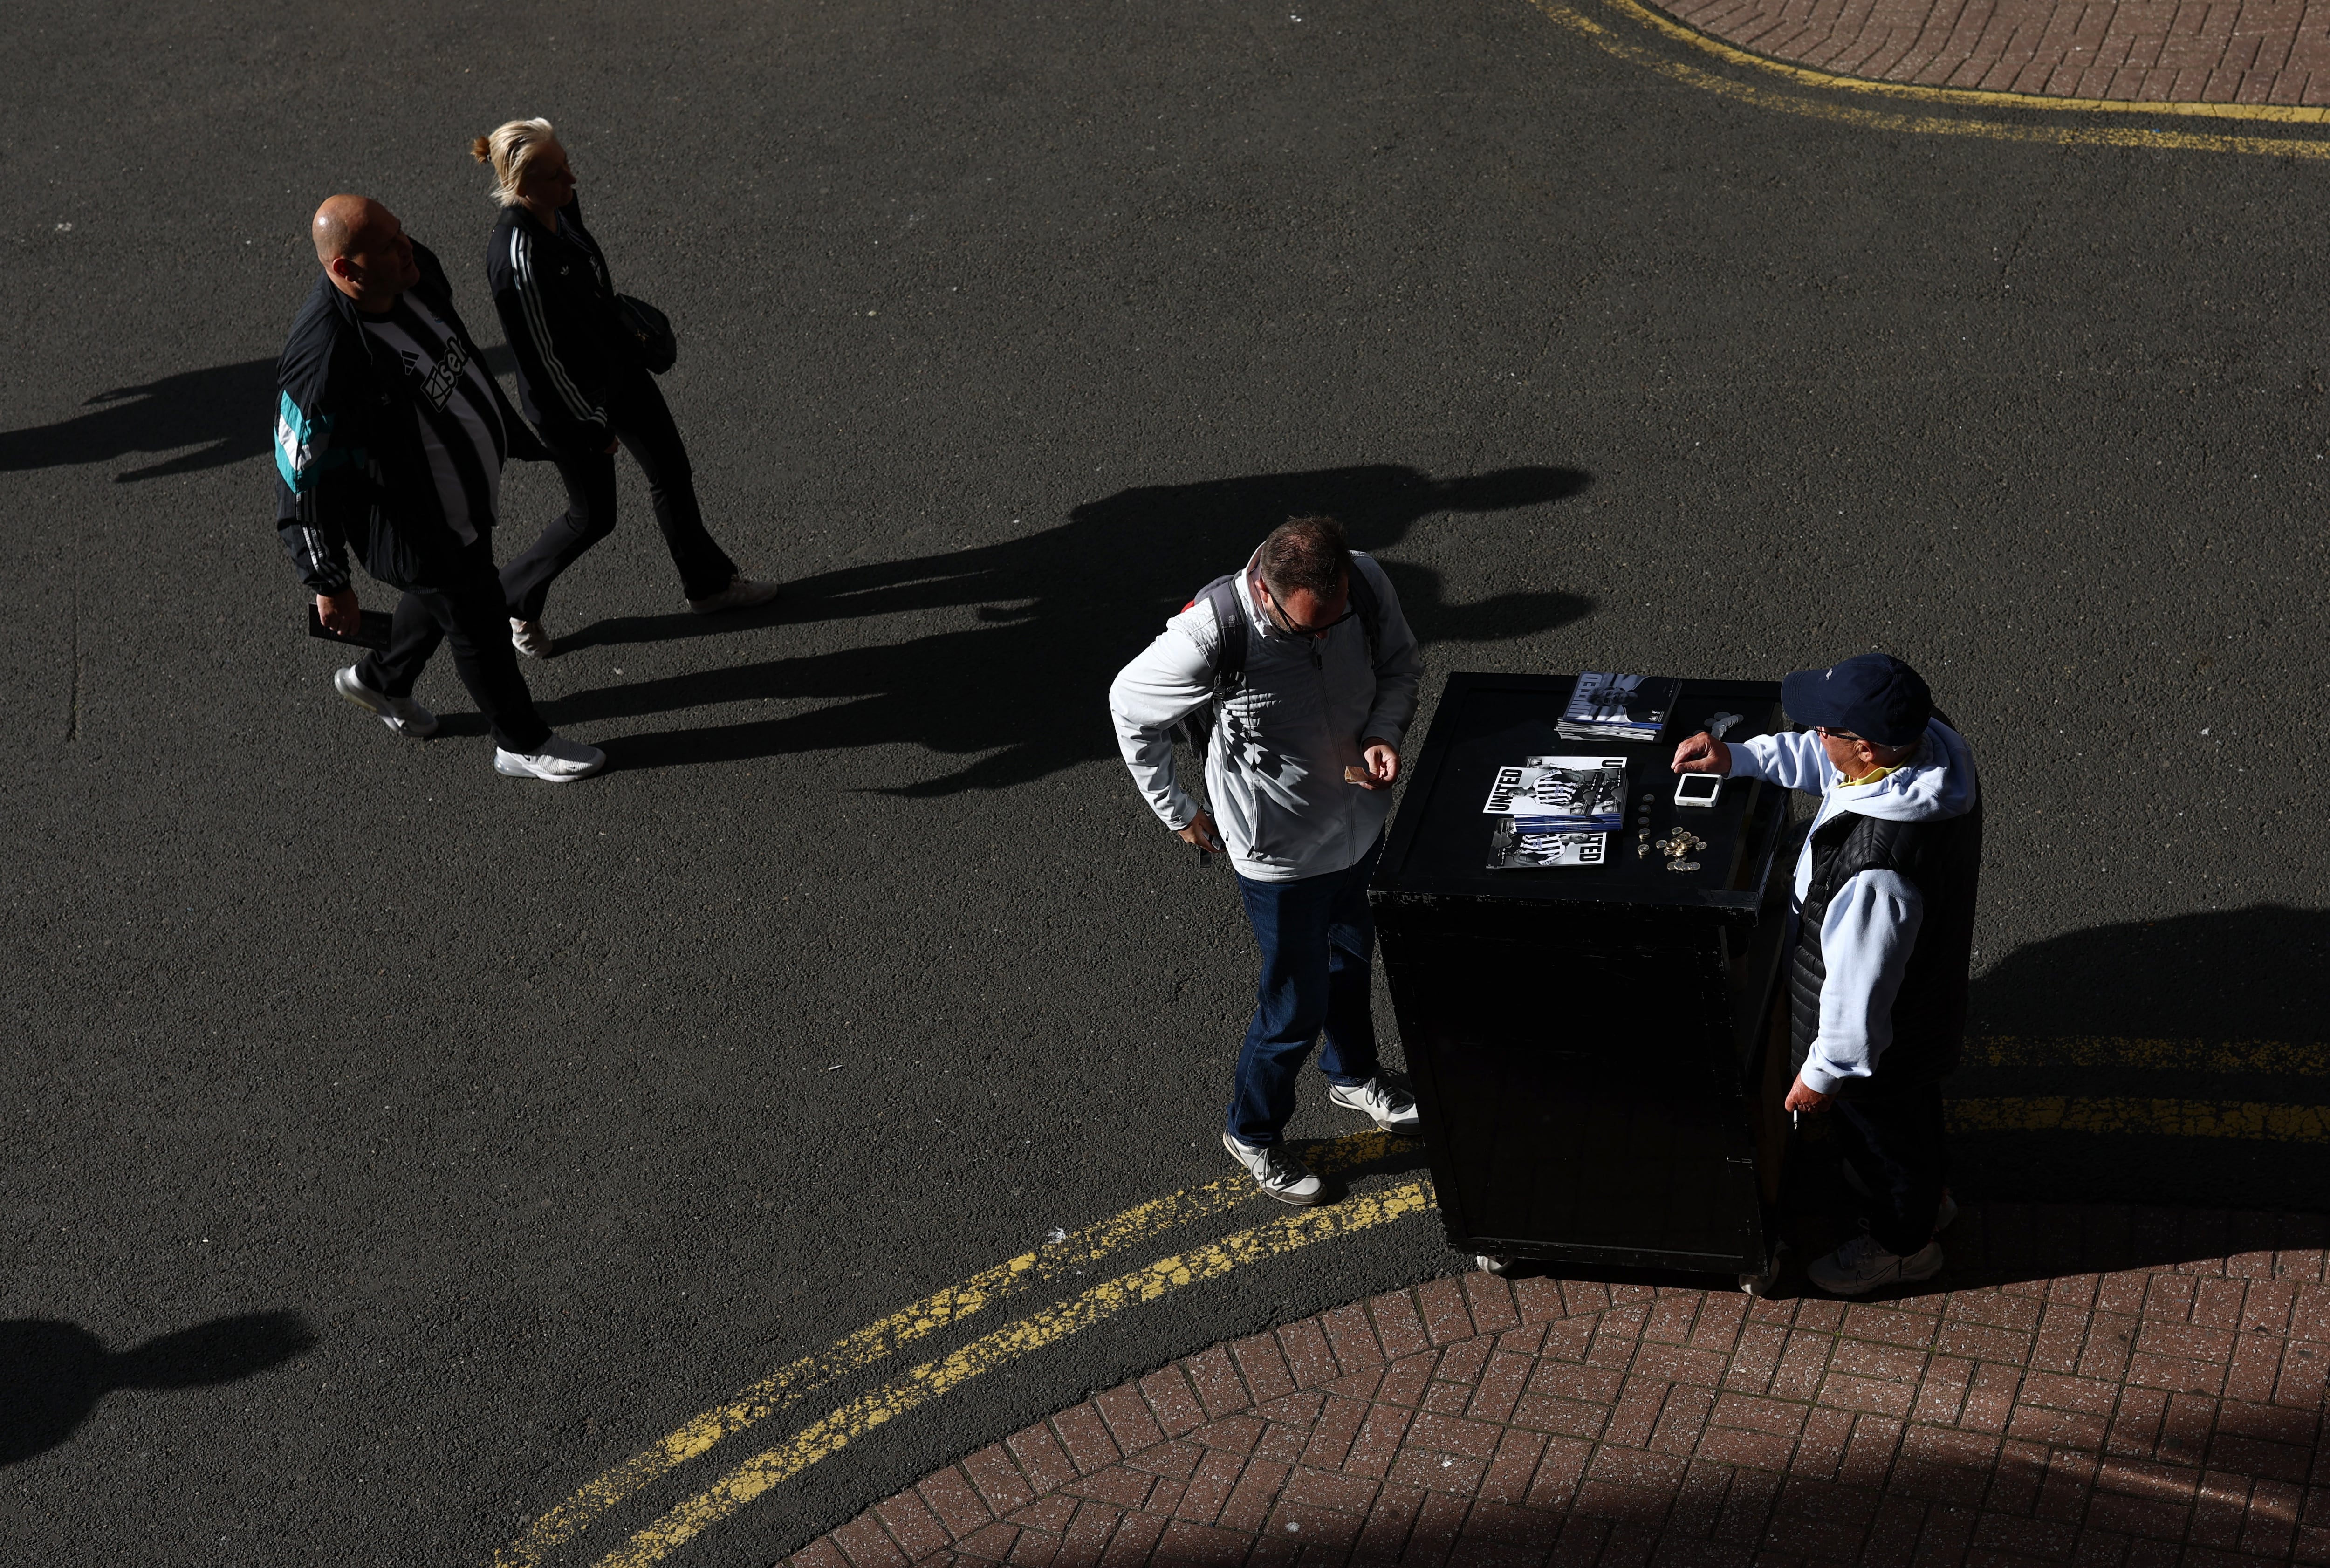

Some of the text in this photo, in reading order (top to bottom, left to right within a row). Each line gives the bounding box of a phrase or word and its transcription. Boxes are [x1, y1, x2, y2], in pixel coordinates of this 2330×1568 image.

[439, 337, 467, 386] sel
[1566, 673, 1603, 717] UNITED
[1487, 769, 1522, 811] UNITED
[1579, 834, 1603, 862] ITED
